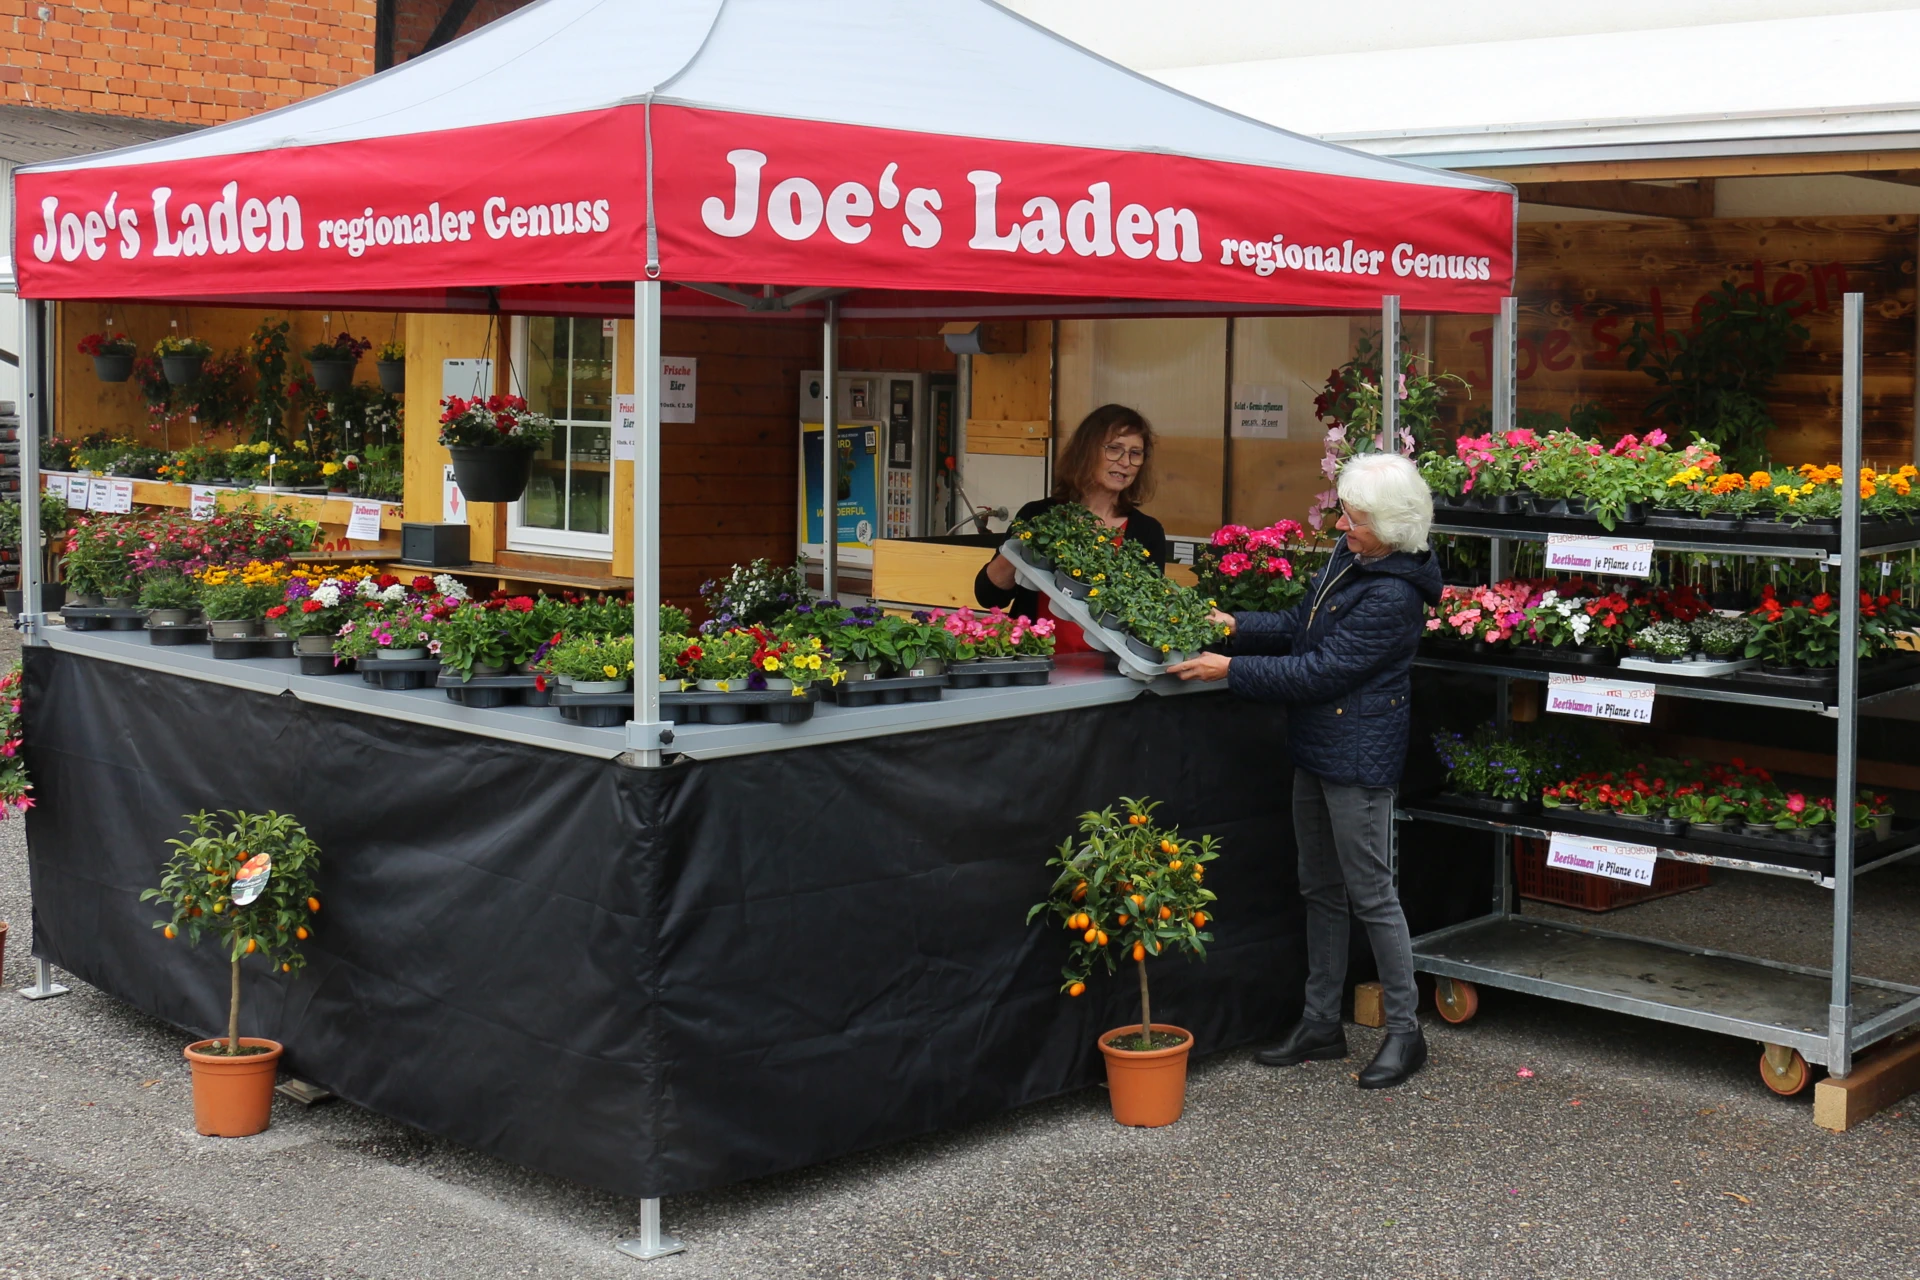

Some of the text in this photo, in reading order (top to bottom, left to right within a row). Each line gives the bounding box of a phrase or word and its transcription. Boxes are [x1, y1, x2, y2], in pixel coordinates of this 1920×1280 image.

[33, 180, 610, 263] Joe's Laden regionaler Genuss
[701, 148, 1490, 281] Joe's Laden regionaler Genuss
[663, 365, 691, 376] Frische
[670, 380, 686, 391] Eier
[1551, 553, 1591, 568] Beetblumen
[1594, 556, 1601, 570] je
[1603, 557, 1629, 571] Pflanze
[1552, 697, 1593, 713] Beetblumen
[1596, 702, 1603, 716] je
[1604, 703, 1630, 718] Pflanze
[1553, 851, 1594, 869] Beetblumen
[1597, 859, 1603, 873] je
[1605, 861, 1631, 877] Pflanze
